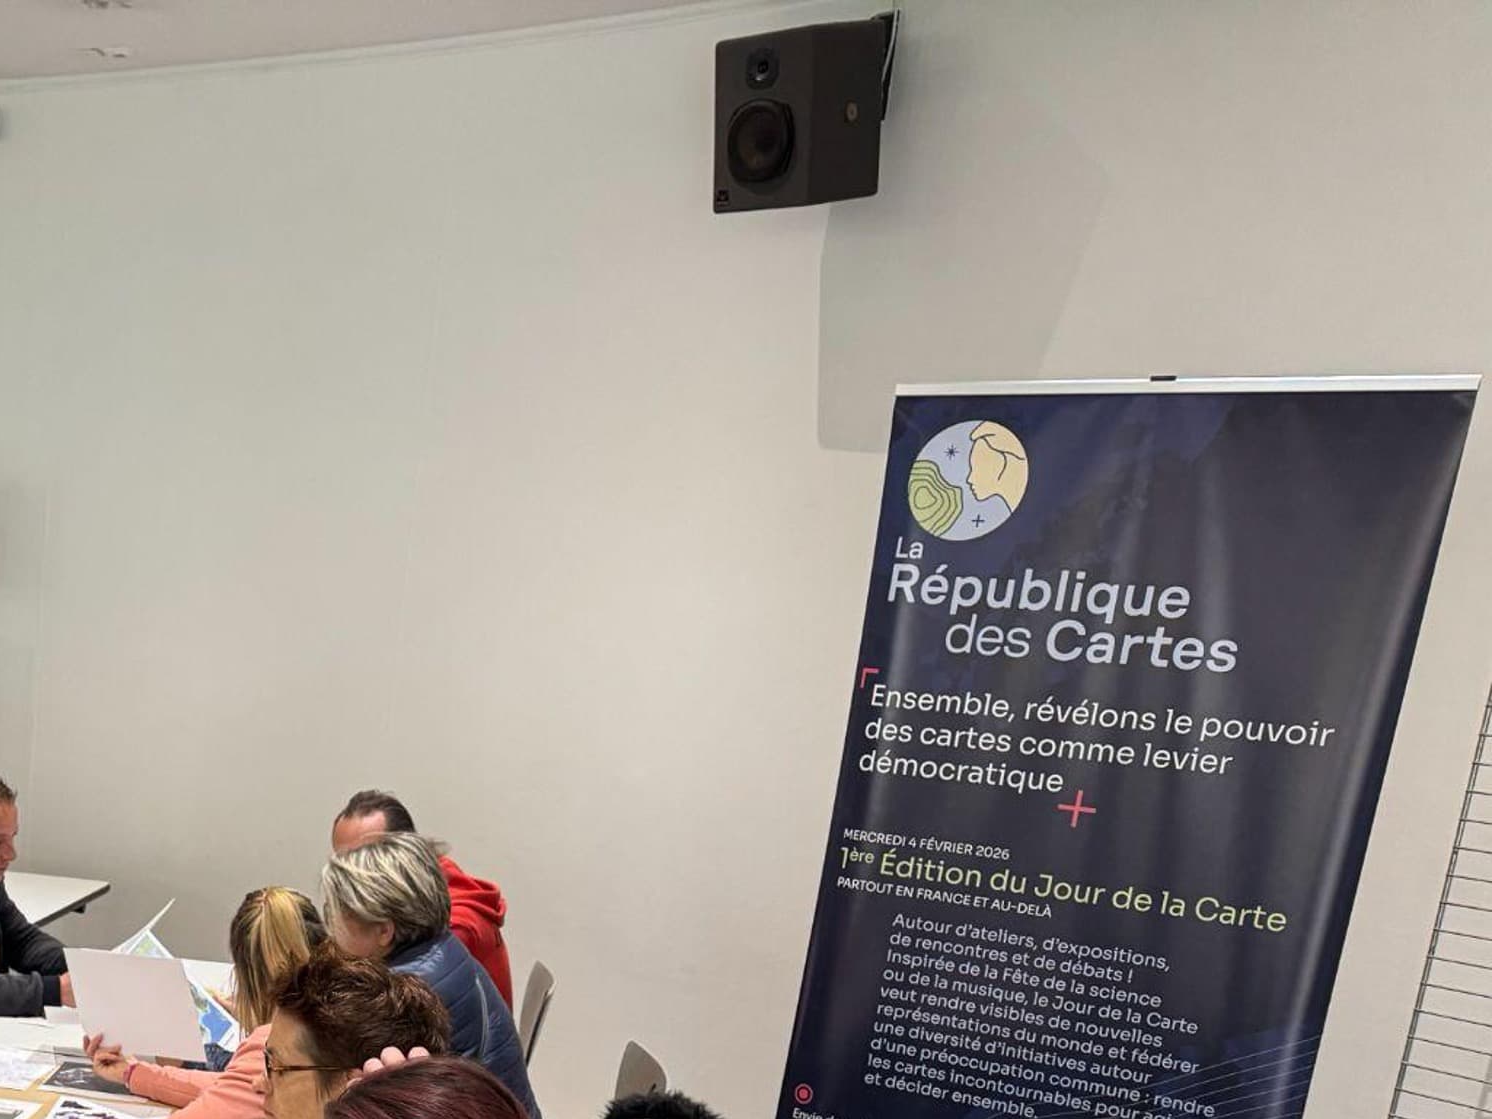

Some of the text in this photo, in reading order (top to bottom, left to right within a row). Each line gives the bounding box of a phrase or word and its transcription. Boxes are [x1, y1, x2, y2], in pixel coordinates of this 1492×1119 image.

[895, 536, 924, 560] La
[887, 562, 1192, 624] République
[945, 614, 1240, 674] des Cartes
[870, 683, 1337, 749] Ensemble, révélons le pouvoir
[858, 749, 1064, 795] démocratique
[864, 716, 1234, 777] des cartes comme levier
[843, 828, 1010, 860] MERCREDI 4 FÉVRIER 2026
[837, 876, 1052, 918] PARTOUT EN FRANCE ET AU-DELÀ
[840, 847, 1287, 932] 1ère Édition du Jour de la Carte
[892, 913, 953, 935] Autour
[887, 949, 1162, 1007] Inspirée de la Fête de la science
[889, 933, 1134, 983] de rencontres et de débats !
[880, 986, 1163, 1047] veut rendre visibles de nouvelles
[883, 969, 1199, 1034] ou de la musique, le Jour de la Carte
[874, 1021, 905, 1036] une
[908, 1026, 981, 1051] diversité
[1090, 1062, 1153, 1084] autour
[877, 1004, 1200, 1074] représentations du monde et fédérer
[864, 1072, 1039, 1119] et décider ensemble.
[867, 1053, 892, 1070] les
[894, 1060, 946, 1081] cartes
[950, 1069, 1092, 1112] incontournables
[919, 1047, 1045, 1083] préoccupation
[1049, 1074, 1141, 1102] commune
[1144, 1092, 1151, 1103] :
[1154, 1094, 1215, 1118] rendre
